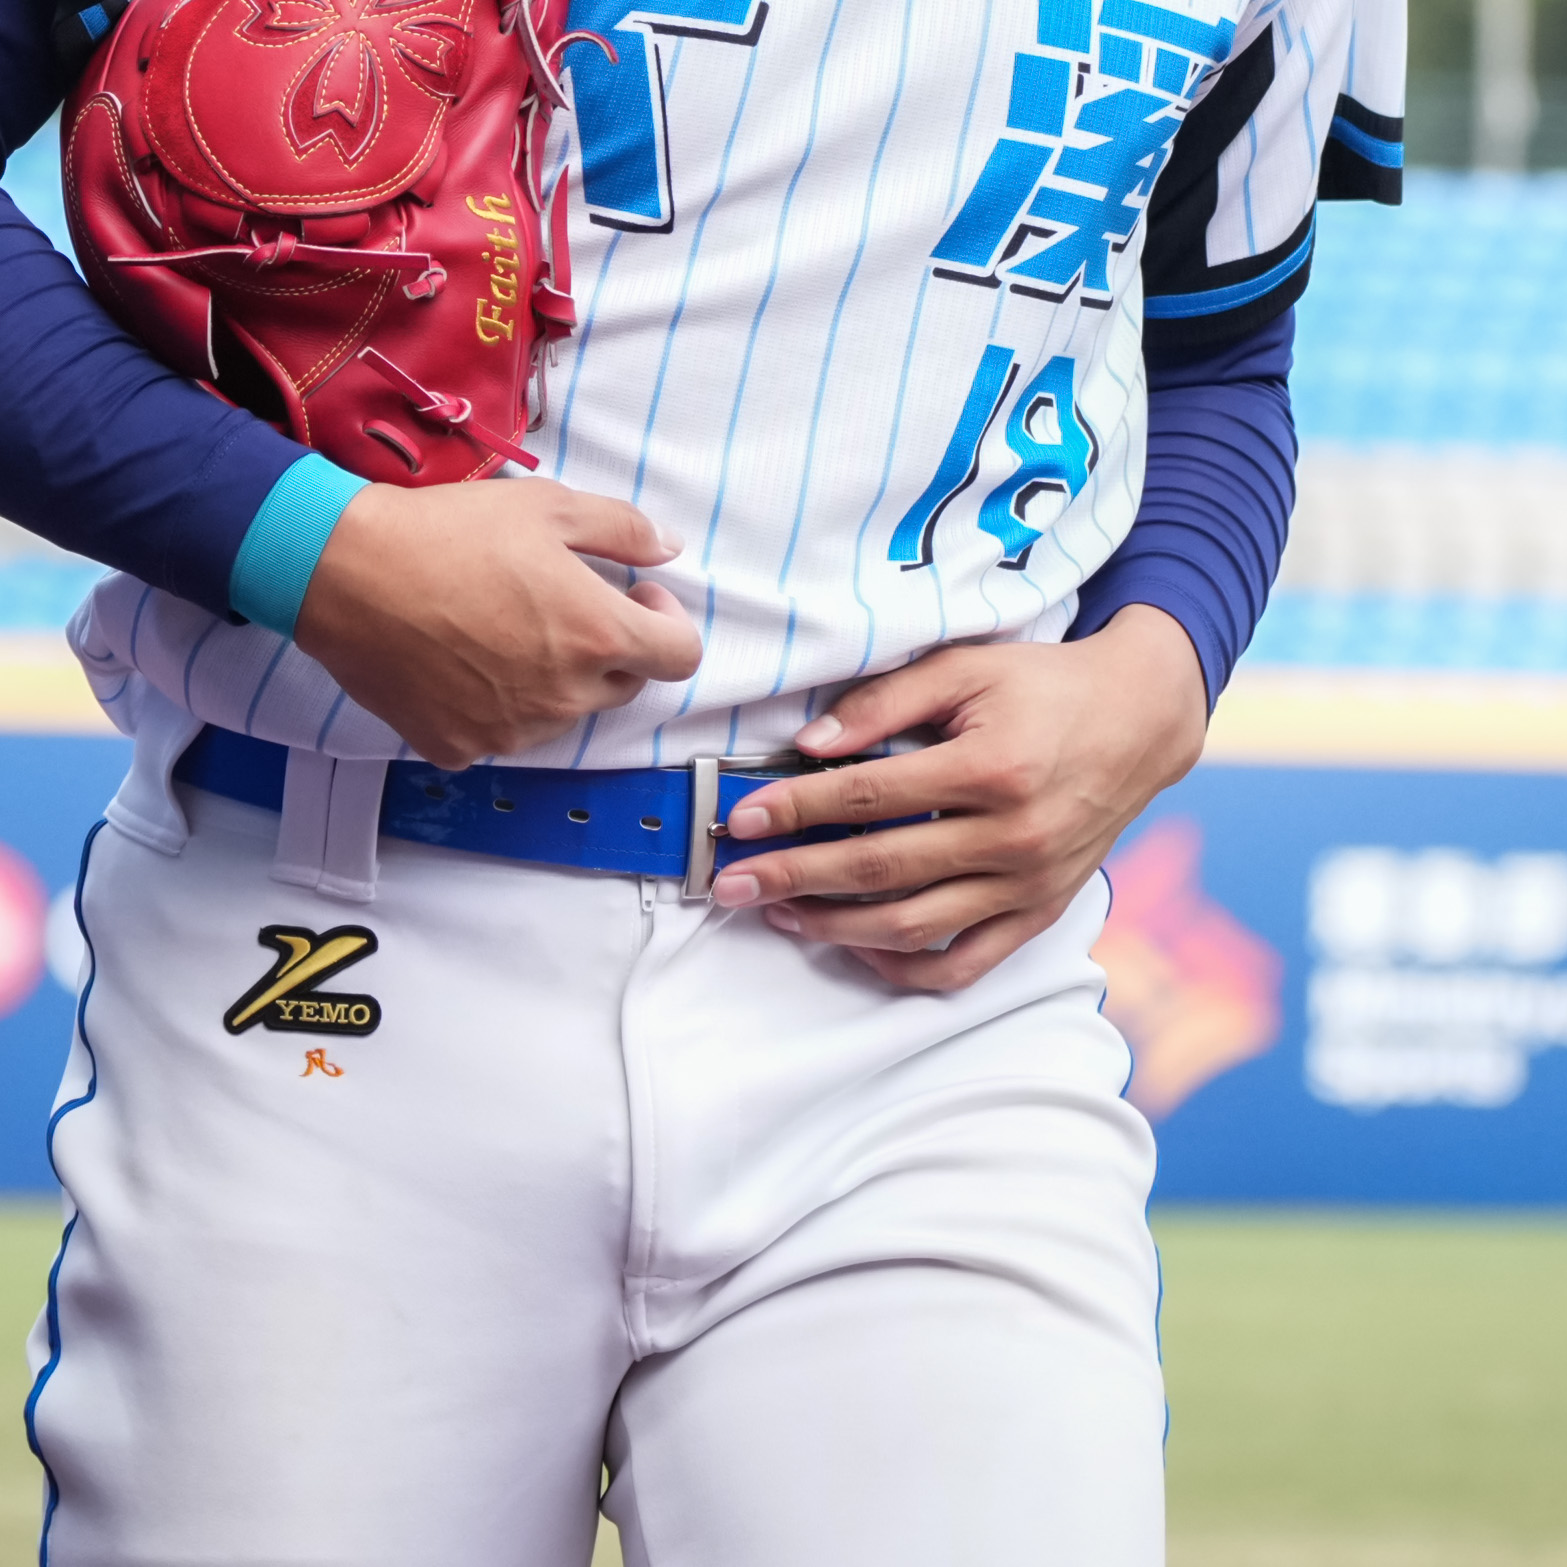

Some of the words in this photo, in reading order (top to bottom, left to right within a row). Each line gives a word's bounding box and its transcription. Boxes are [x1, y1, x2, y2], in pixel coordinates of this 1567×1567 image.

[466, 193, 520, 347] Faith
[887, 344, 1098, 564] 18
[275, 999, 371, 1025] YEMO
